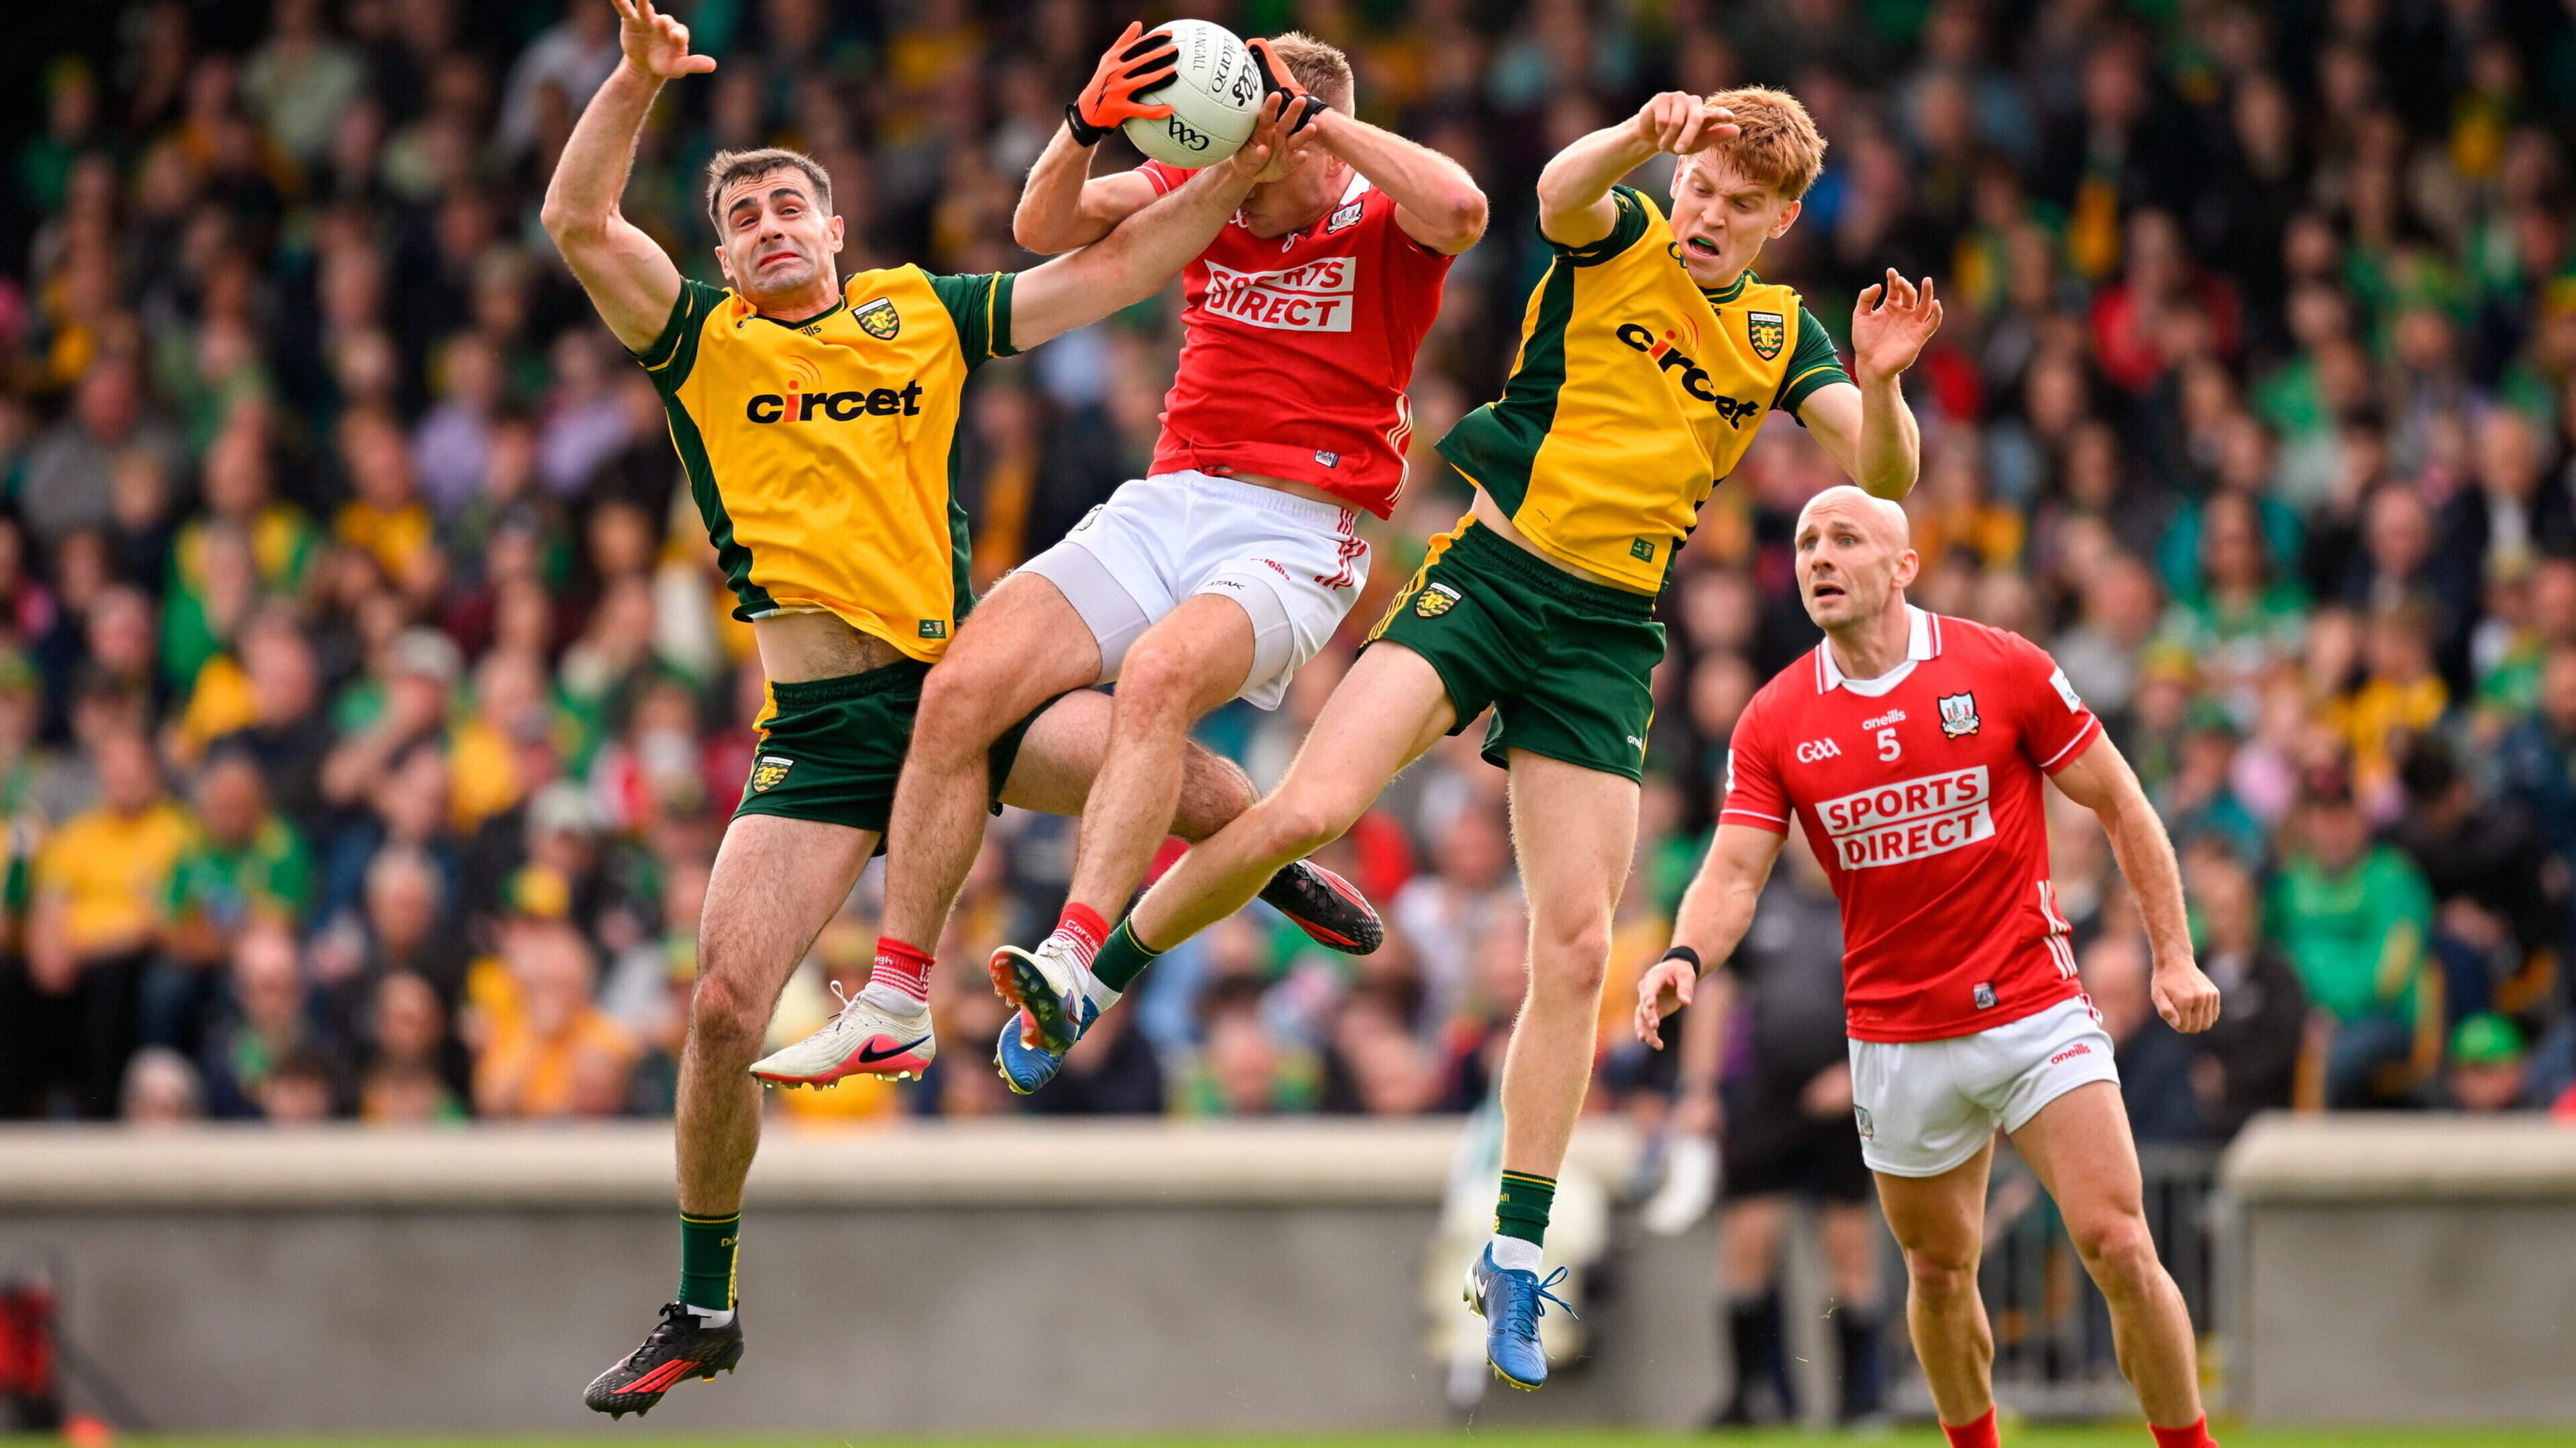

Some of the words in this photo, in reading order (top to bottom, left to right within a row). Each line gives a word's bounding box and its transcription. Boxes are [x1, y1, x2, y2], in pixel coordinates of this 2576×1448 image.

[1212, 262, 1346, 292] SRTS
[1210, 289, 1340, 327] DIRECT
[1615, 323, 1760, 430] circet
[747, 379, 922, 423] circet
[1796, 737, 1842, 763] GAA
[1876, 727, 1901, 762] 5
[1828, 773, 1978, 831] SPORTS
[1843, 810, 1980, 865] DIRECT
